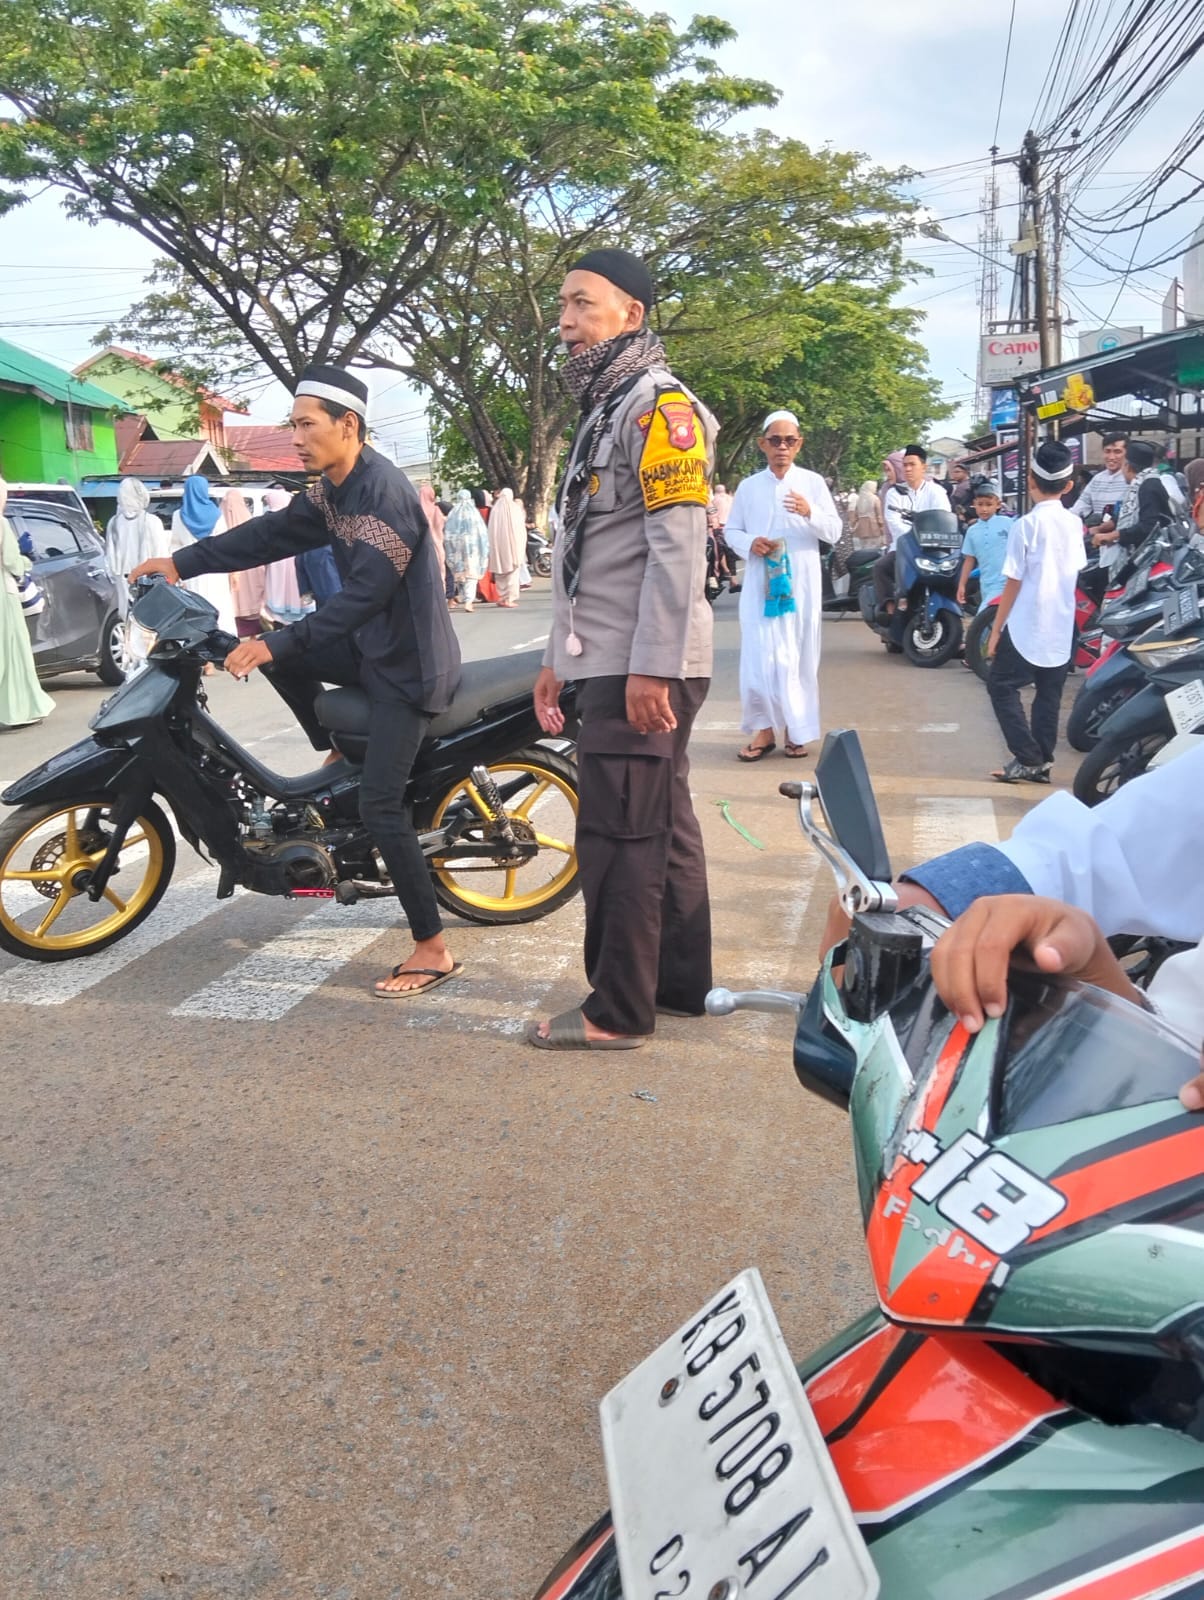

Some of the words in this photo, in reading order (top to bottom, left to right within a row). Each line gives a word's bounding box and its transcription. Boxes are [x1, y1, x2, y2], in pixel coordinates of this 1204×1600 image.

[988, 339, 1039, 356] Cano
[681, 1288, 747, 1378] KB
[698, 1351, 793, 1516] 5708
